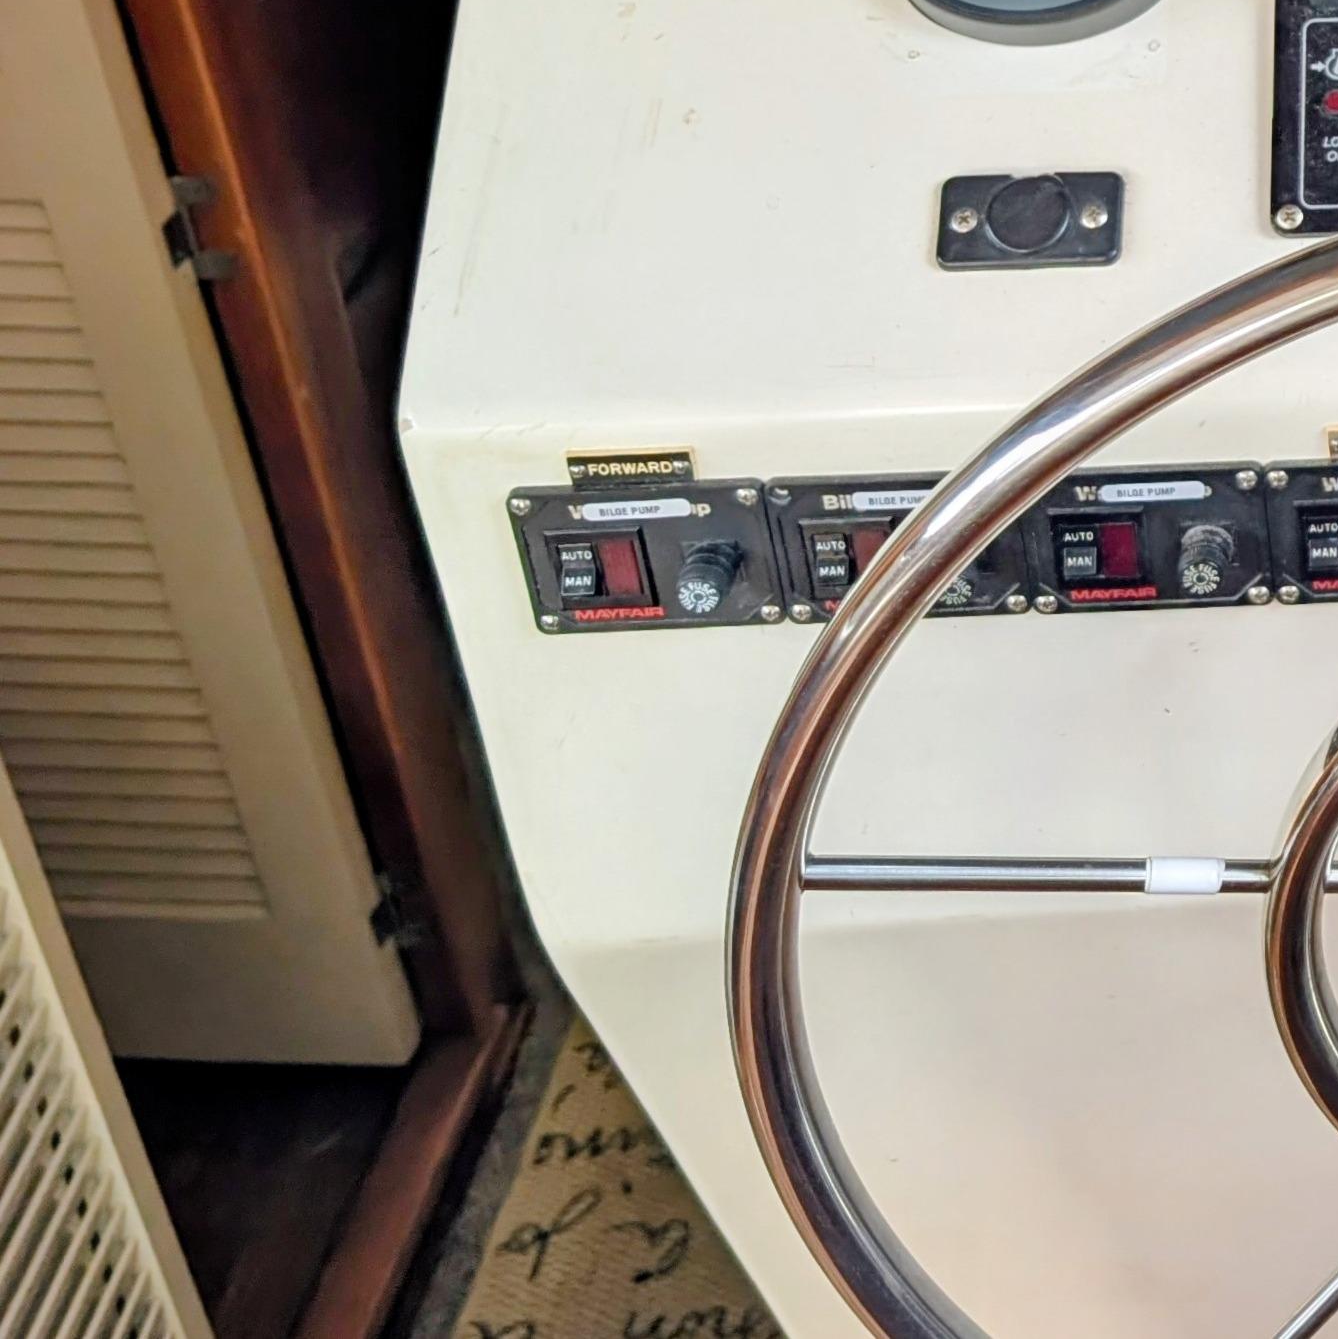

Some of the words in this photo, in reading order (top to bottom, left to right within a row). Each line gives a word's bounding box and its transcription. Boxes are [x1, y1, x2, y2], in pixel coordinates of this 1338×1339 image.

[587, 460, 673, 476] FORWARD
[1117, 489, 1145, 498] BILGE
[1147, 487, 1176, 496] PUMP
[868, 496, 897, 505] BILGE
[598, 507, 628, 517] BILGE
[631, 505, 661, 515] PUMP
[1308, 522, 1338, 533] AUTO
[1064, 531, 1094, 542] AUTO
[816, 540, 846, 551] AUTO
[561, 549, 593, 560] AUTO
[1312, 547, 1338, 558] MAN
[1067, 556, 1093, 567] MAN
[818, 565, 845, 576] MAN
[565, 575, 592, 587] MAN
[1070, 586, 1158, 601] MAYFAIR
[574, 606, 665, 621] MAYFAIR
